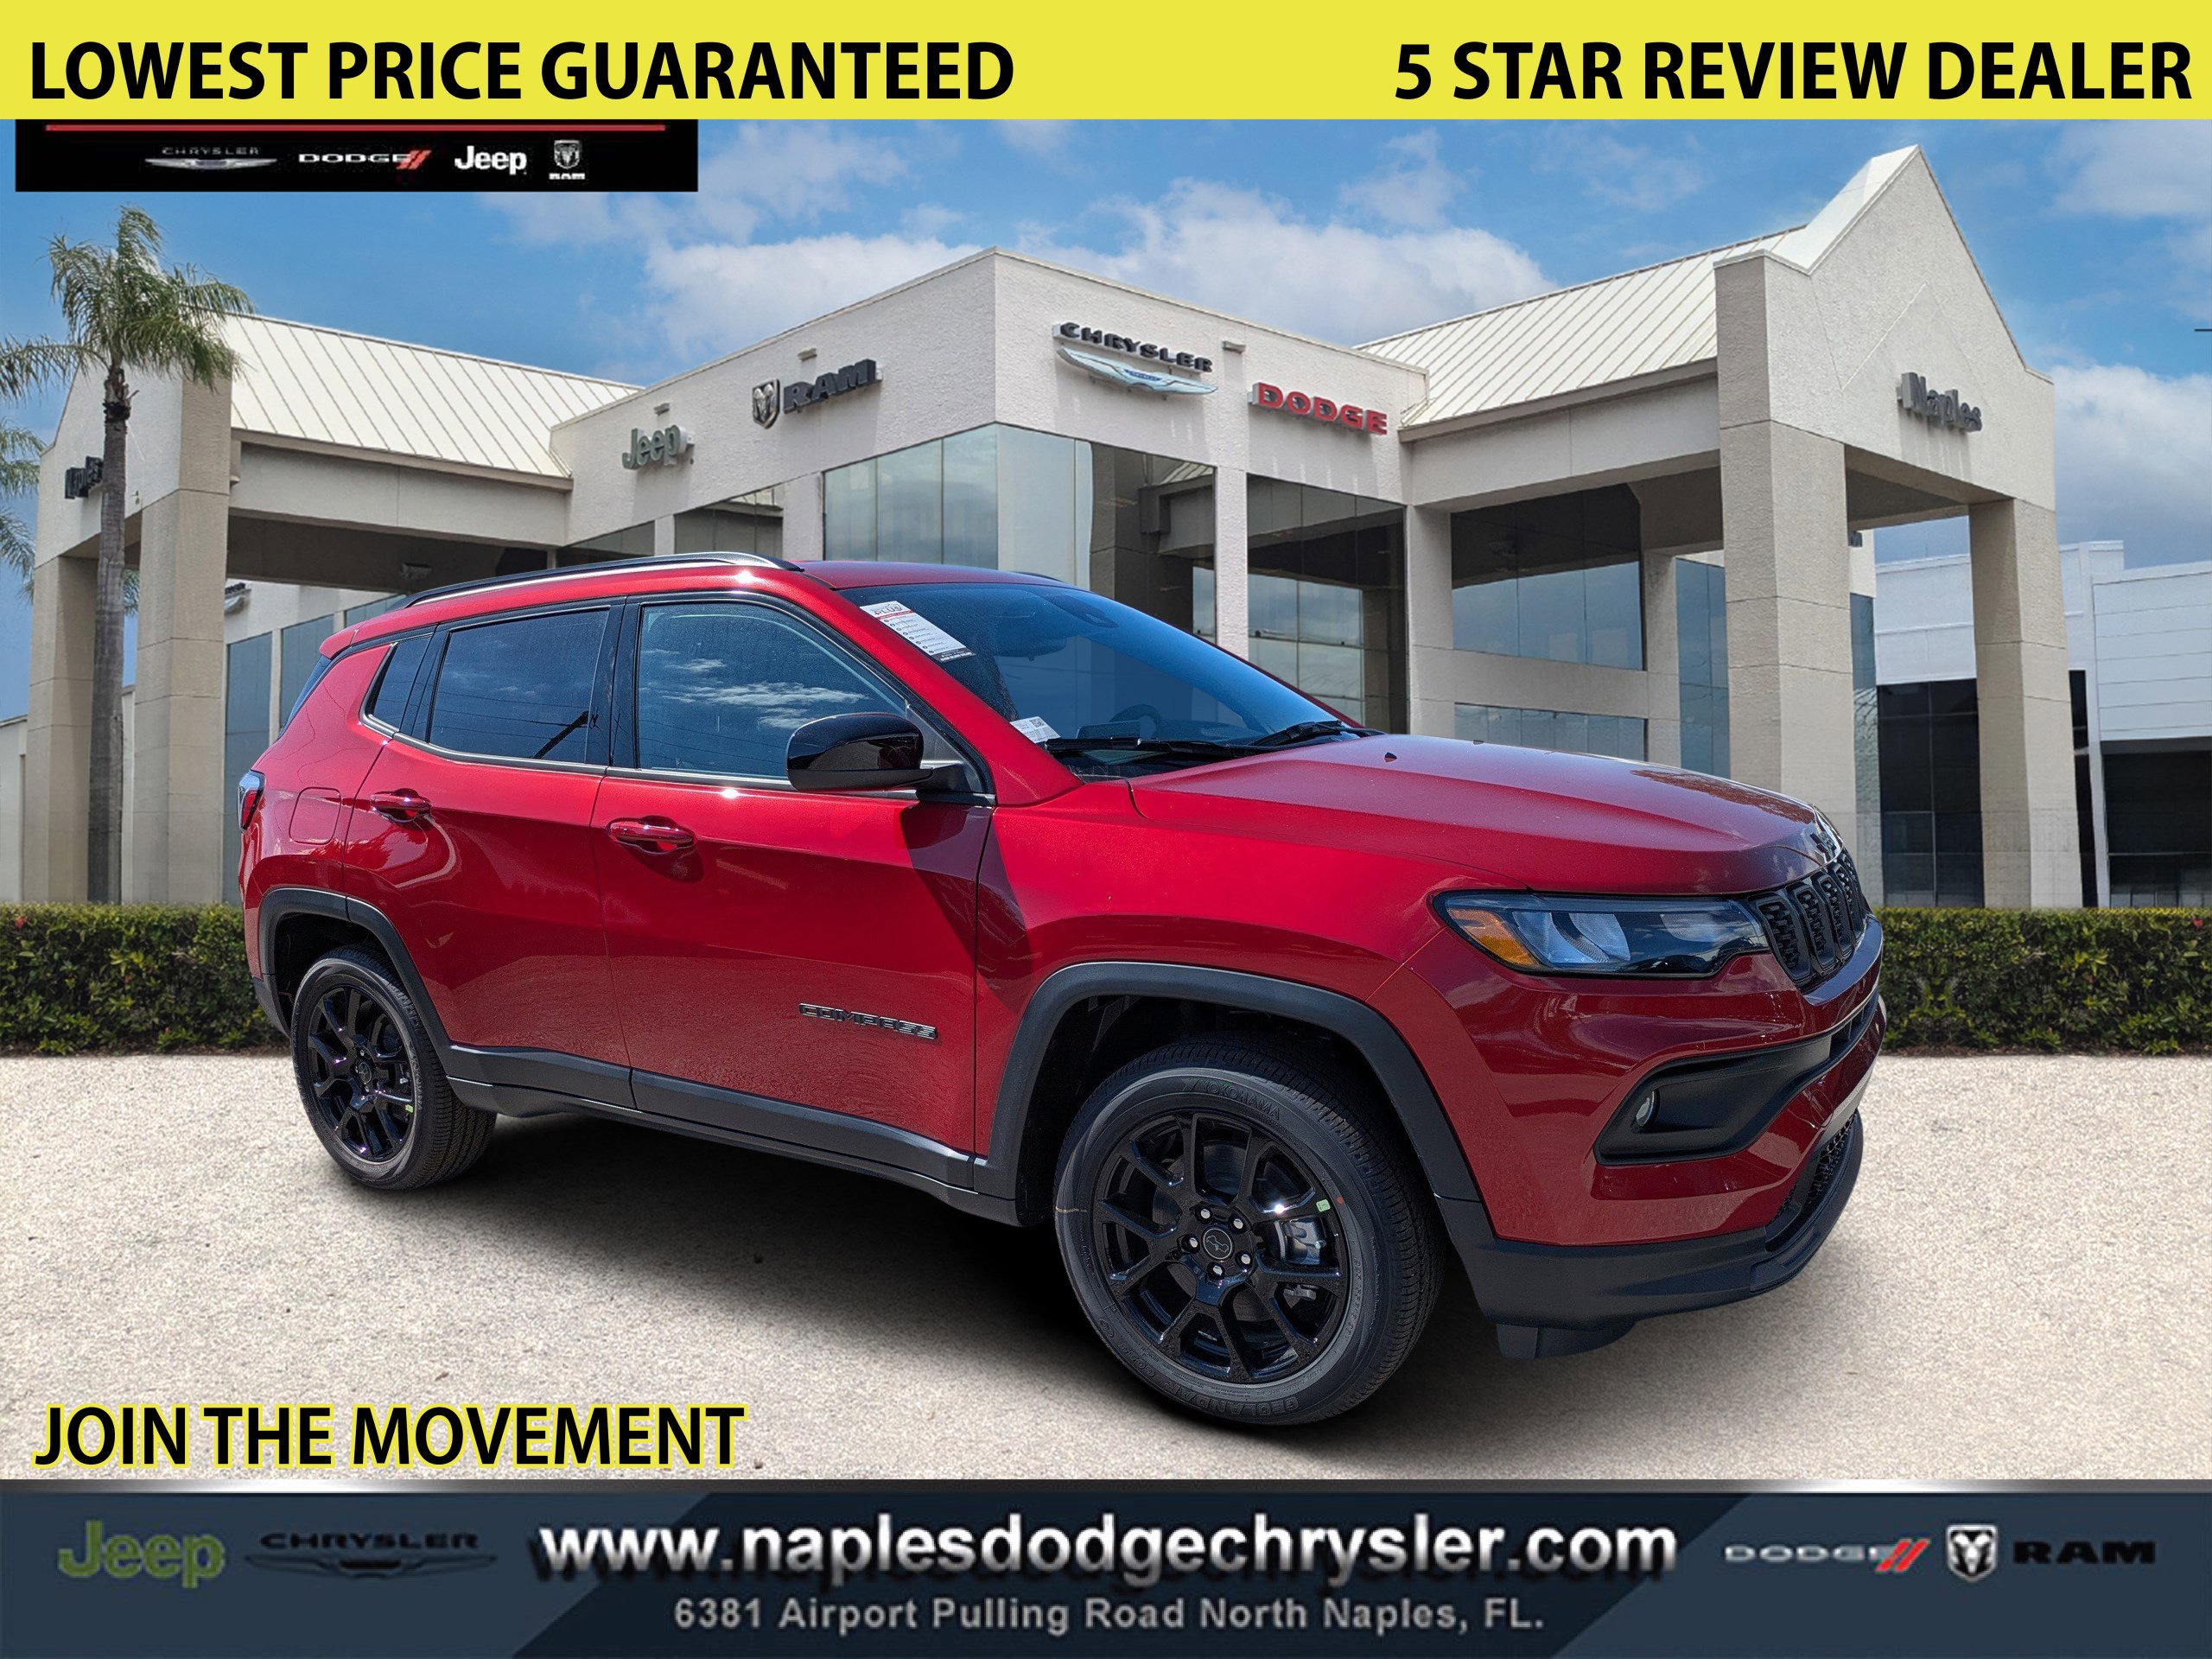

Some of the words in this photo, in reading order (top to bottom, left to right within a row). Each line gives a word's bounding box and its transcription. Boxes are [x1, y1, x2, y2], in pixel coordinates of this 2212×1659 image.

[1058, 321, 1214, 373] CHRYSLER
[783, 358, 881, 415] RAM
[1255, 381, 1388, 435] DODGE
[1900, 372, 1983, 432] Naples
[621, 423, 684, 470] Jeep
[798, 1002, 938, 1040] COMPASS
[1201, 1079, 1280, 1121] YOKOHAMA
